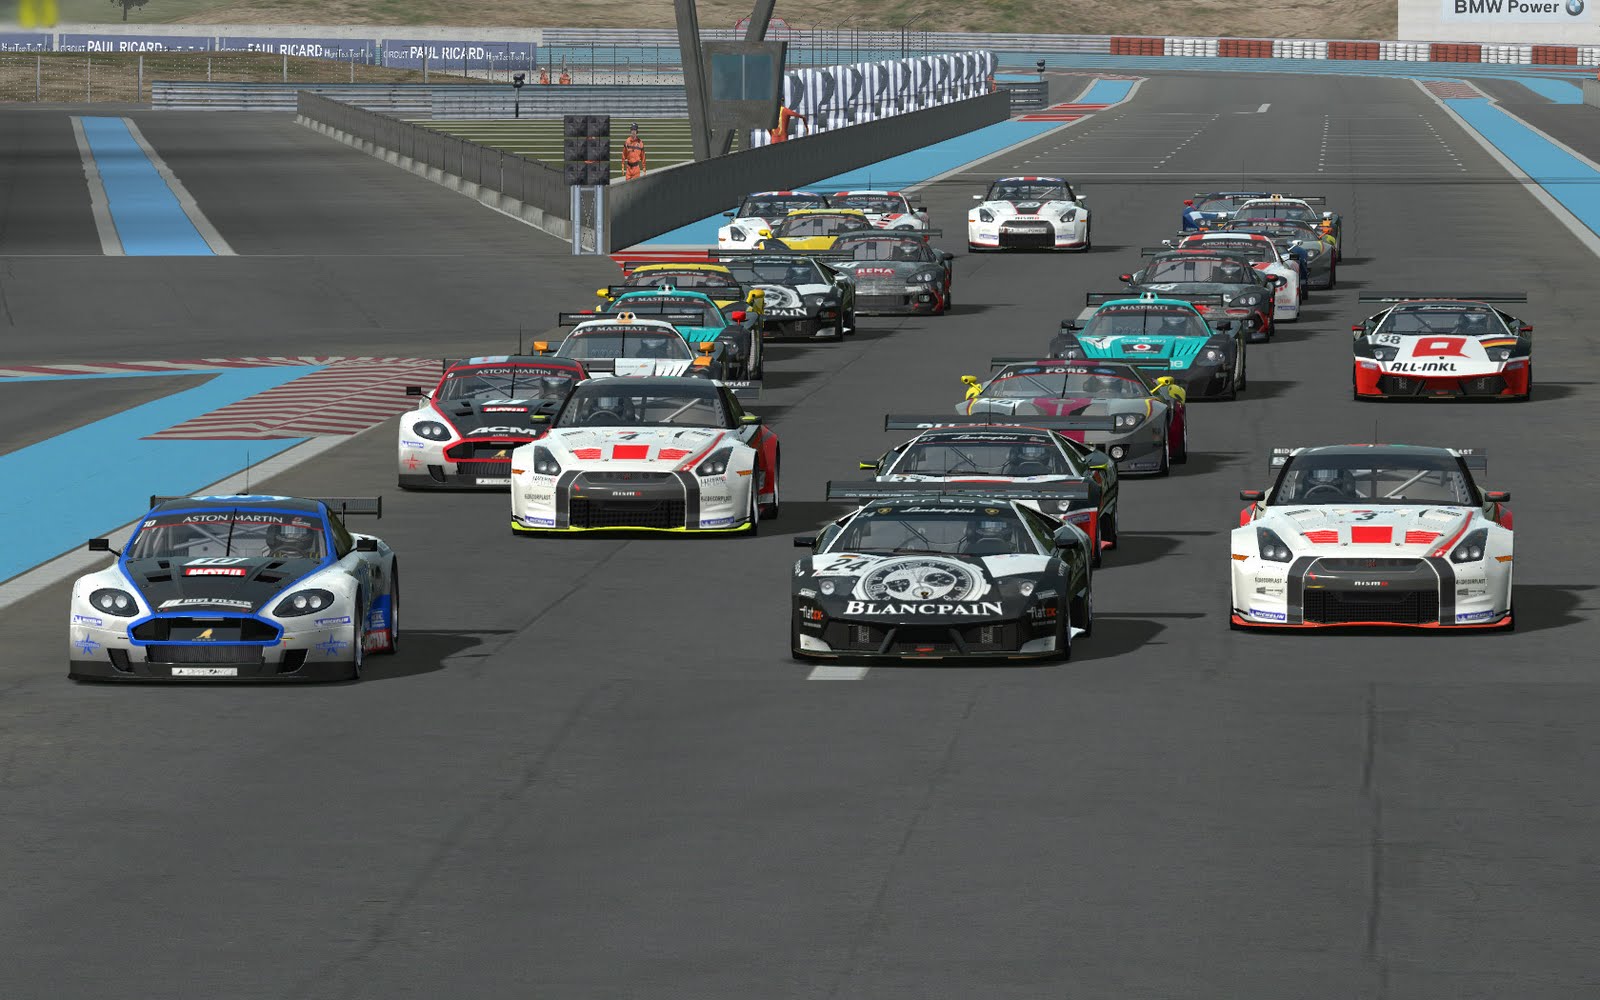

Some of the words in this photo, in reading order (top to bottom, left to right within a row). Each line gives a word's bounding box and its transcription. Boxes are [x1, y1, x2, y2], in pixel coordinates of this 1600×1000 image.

[1454, 0, 1502, 14] BMW
[1508, 0, 1560, 14] Power
[119, 41, 163, 52] RICARD
[279, 44, 323, 57] RICARD
[410, 46, 439, 59] PAUL
[442, 47, 484, 60] RICARD
[1379, 334, 1401, 345] 38
[466, 426, 537, 436] ACM
[951, 434, 1019, 442] Lamborghini
[900, 505, 976, 515] Lamborghini
[142, 519, 157, 528] 10
[183, 514, 229, 523] ASTON
[233, 514, 283, 524] MARTIN
[1355, 512, 1378, 521] 3
[822, 558, 872, 572] 24
[843, 600, 1003, 616] BLANCPAIN
